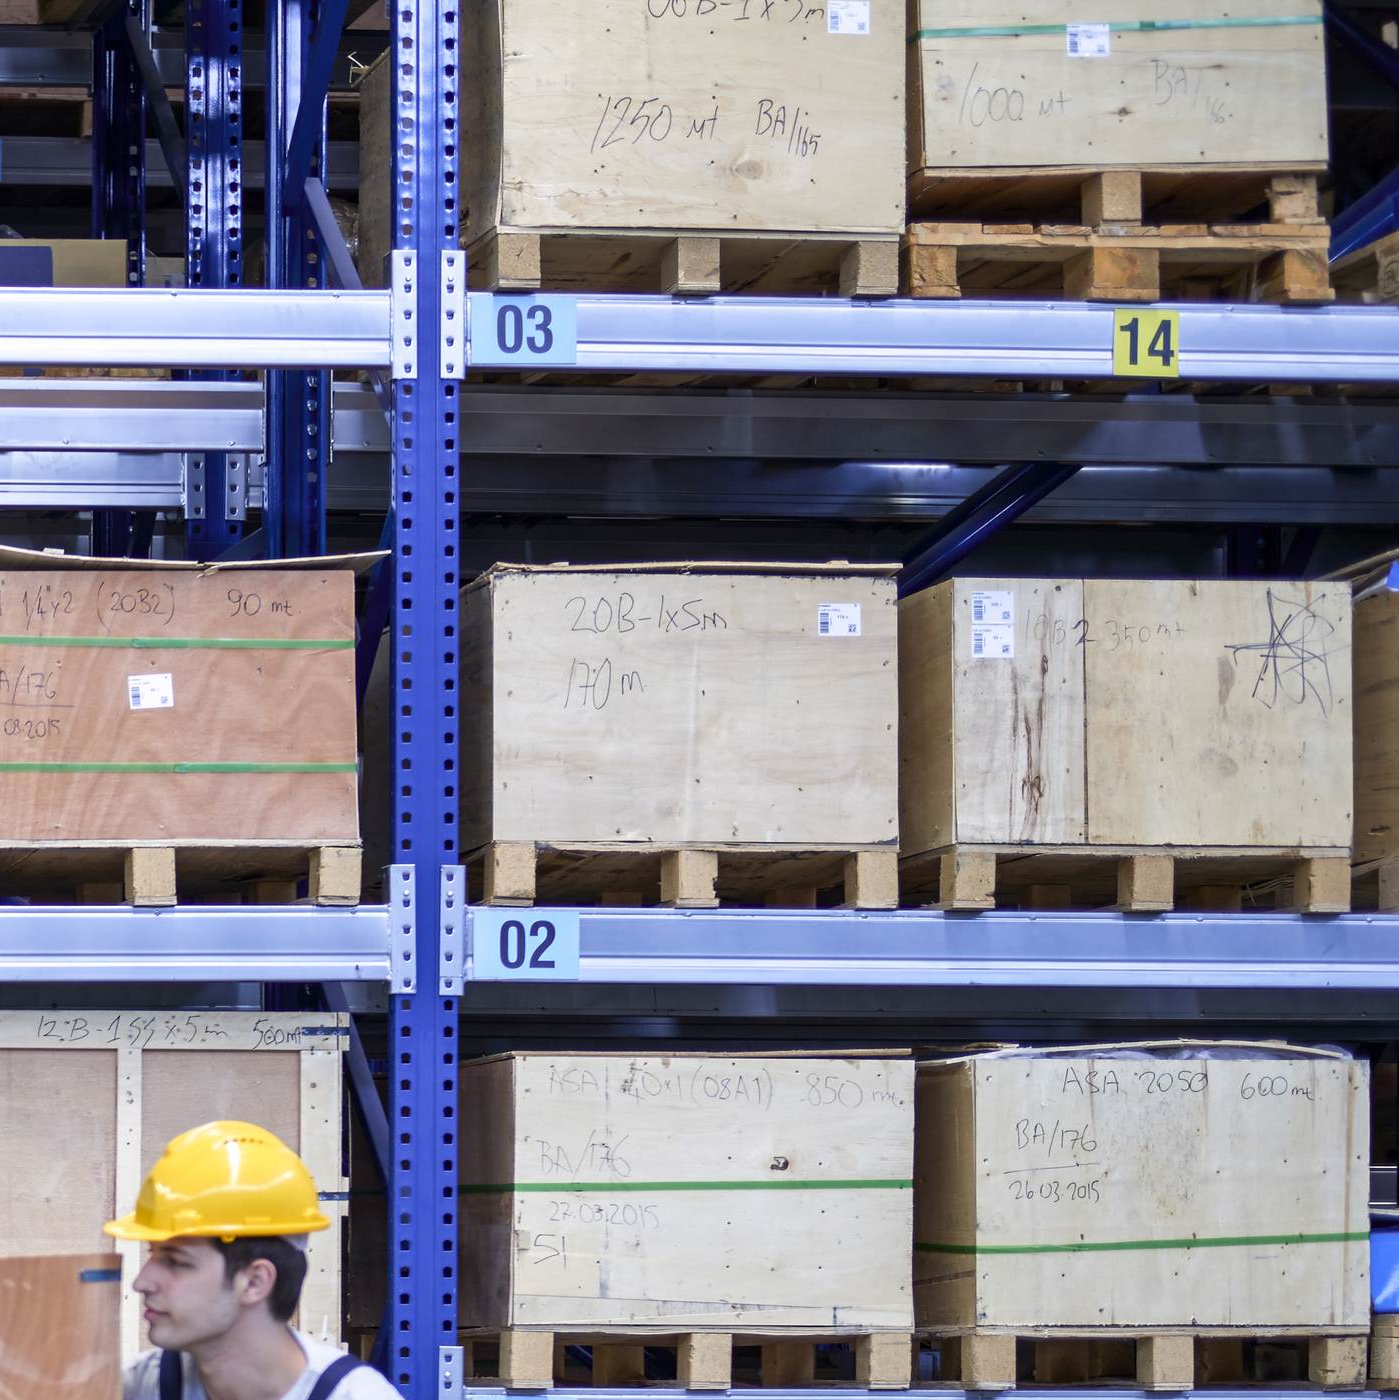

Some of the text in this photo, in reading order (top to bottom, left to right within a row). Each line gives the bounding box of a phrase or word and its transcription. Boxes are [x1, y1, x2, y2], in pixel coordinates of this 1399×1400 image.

[589, 94, 672, 155] 1250
[496, 304, 554, 354] 03
[1119, 317, 1175, 366] 14
[227, 589, 261, 617] 90
[564, 658, 611, 710] 170
[499, 920, 555, 968] 02
[549, 1068, 598, 1095] ASA
[806, 1070, 863, 1108] 850
[1062, 1067, 1120, 1095] ASA
[1142, 1069, 1208, 1095] 2050
[1241, 1073, 1287, 1101] 600
[1015, 1118, 1097, 1157] BA/176
